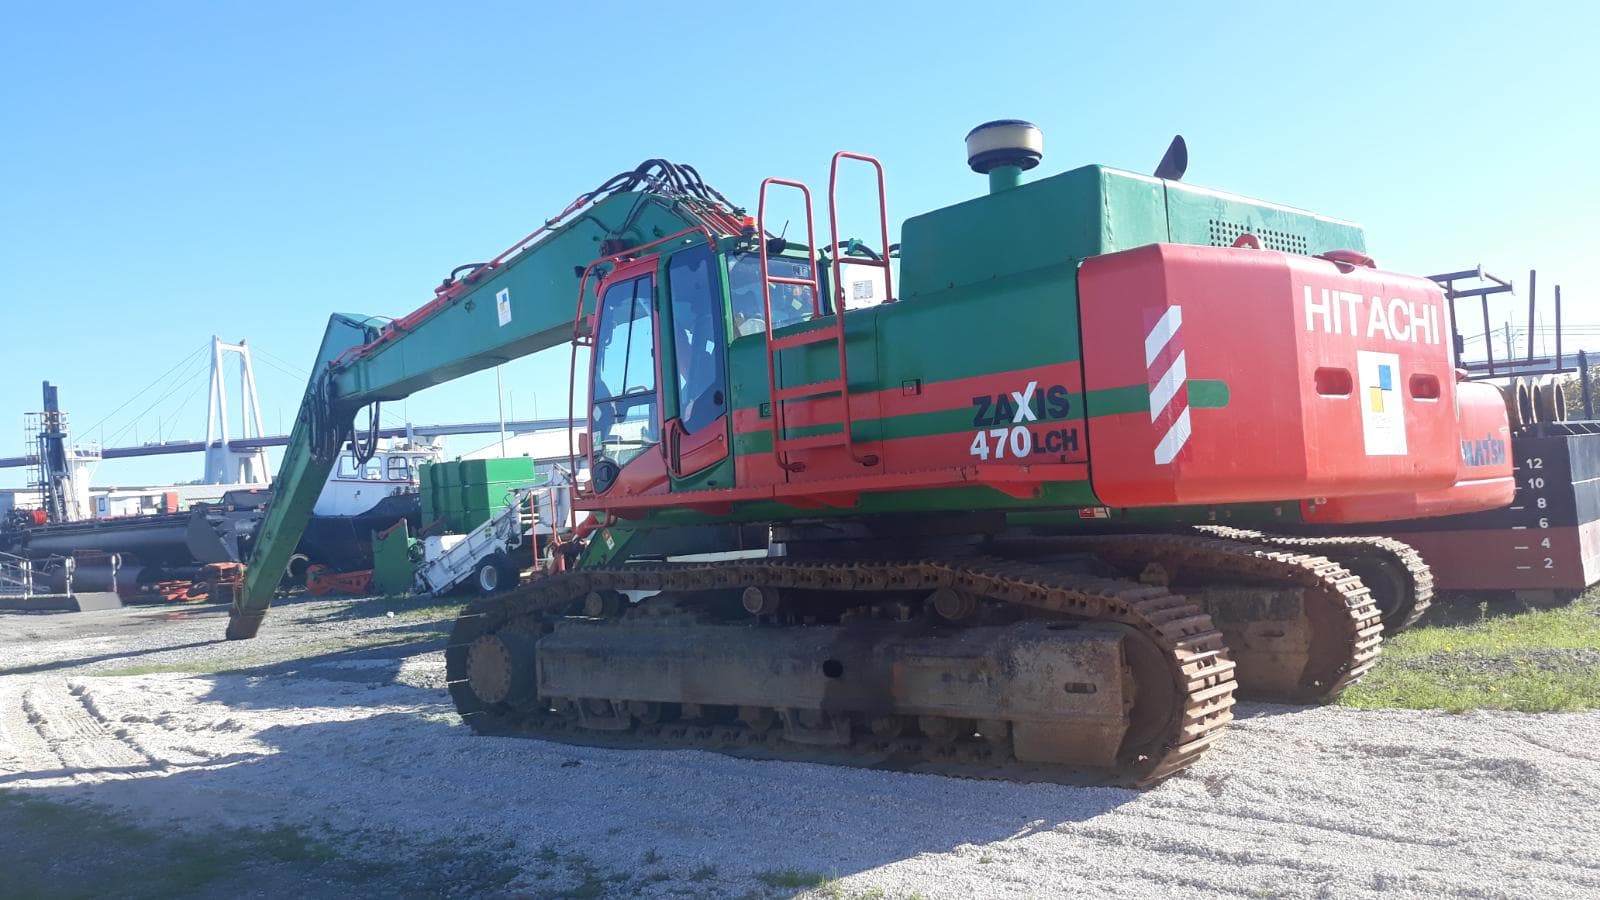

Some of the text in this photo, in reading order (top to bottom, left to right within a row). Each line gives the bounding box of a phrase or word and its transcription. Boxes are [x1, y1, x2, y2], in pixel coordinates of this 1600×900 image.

[1303, 285, 1440, 345] HITACHI
[972, 381, 1070, 427] ZAXIS
[1526, 458, 1543, 469] 12
[1528, 478, 1544, 489] 10
[1537, 498, 1547, 509] 8
[1539, 518, 1549, 529] 6
[1541, 538, 1551, 549] 4
[1543, 558, 1553, 569] 2
